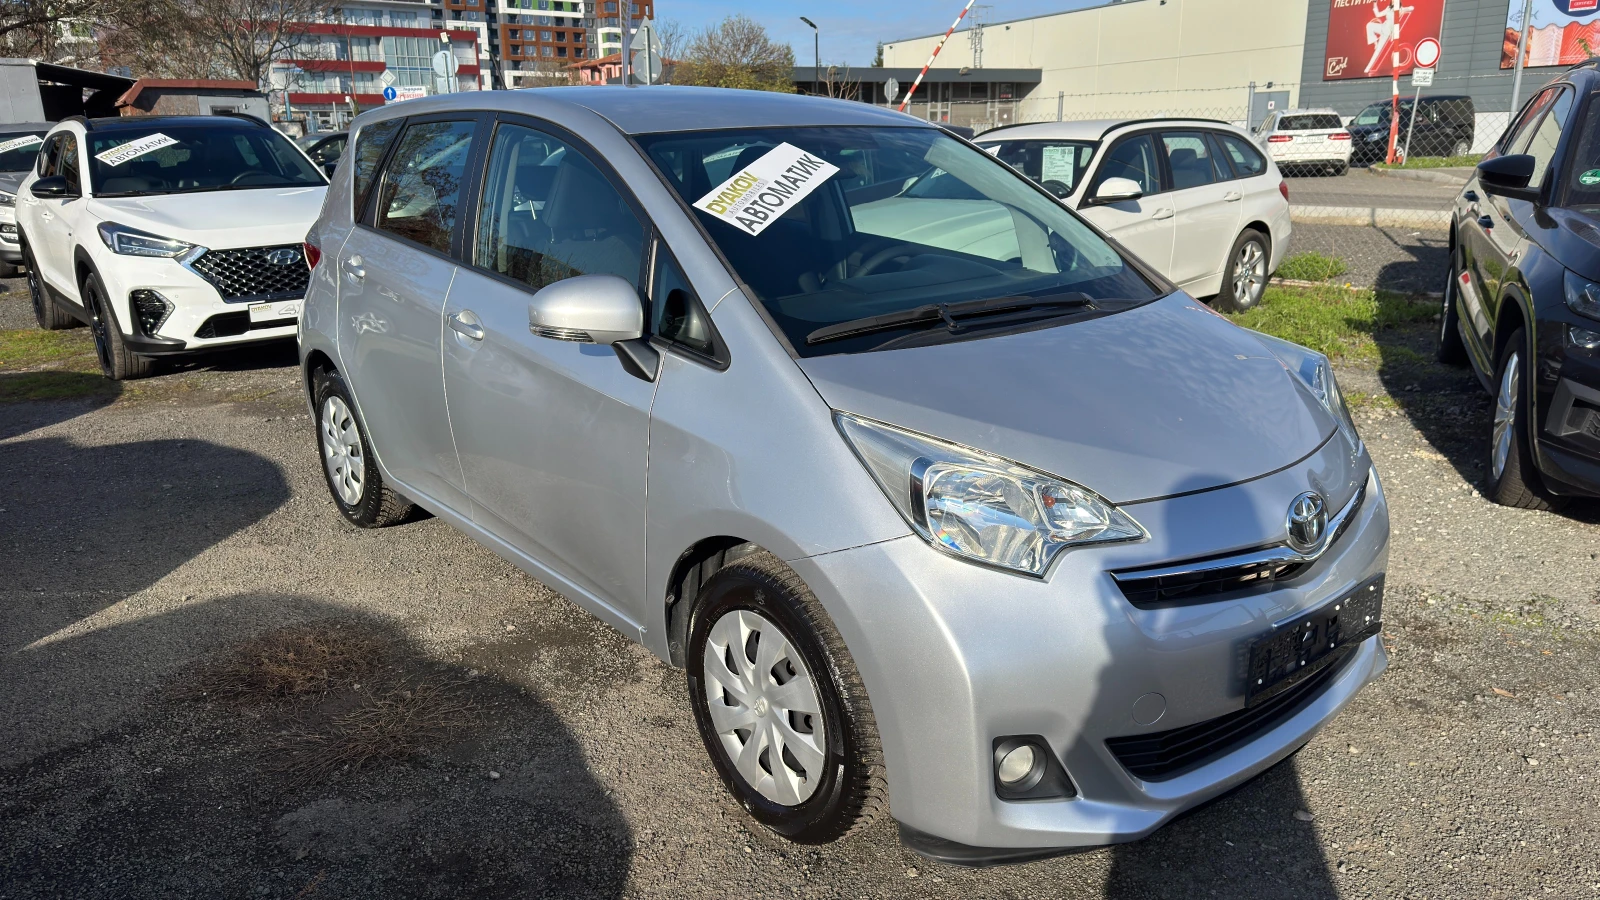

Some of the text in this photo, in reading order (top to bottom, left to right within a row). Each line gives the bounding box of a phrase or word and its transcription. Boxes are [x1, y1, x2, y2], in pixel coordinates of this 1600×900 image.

[0, 137, 40, 151] ВТОМАТИК
[110, 137, 172, 165] АВТОМАТИК
[705, 171, 759, 215] DYAKOV
[728, 181, 765, 215] AUTOMOBILES
[735, 154, 825, 232] АВТОМАТИК
